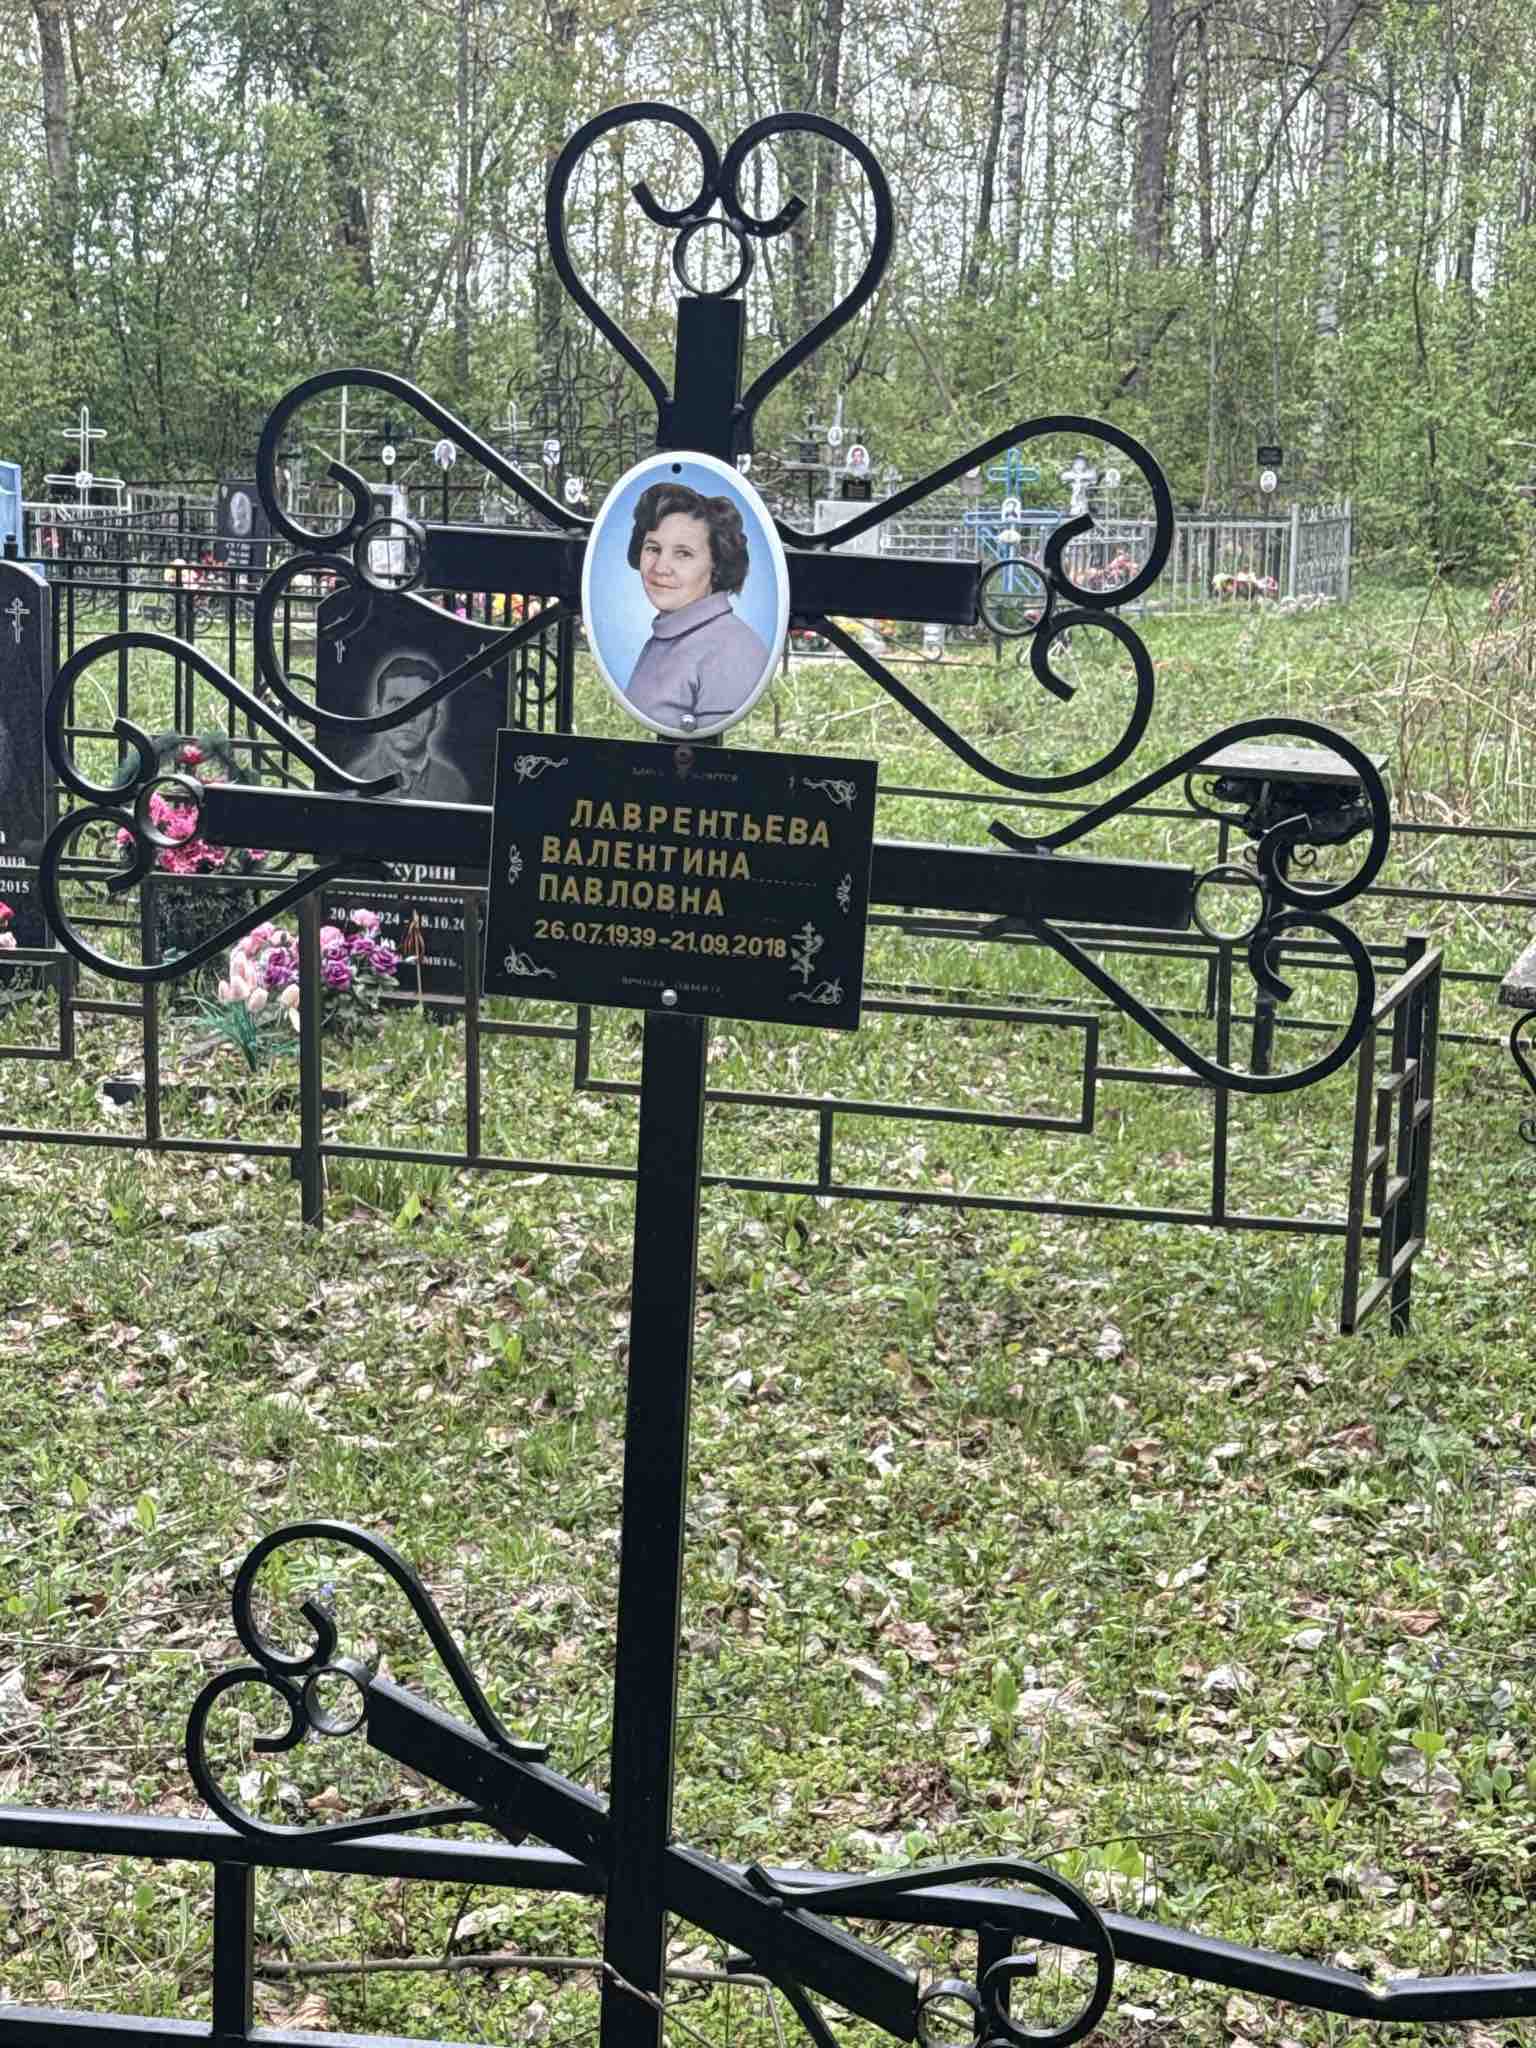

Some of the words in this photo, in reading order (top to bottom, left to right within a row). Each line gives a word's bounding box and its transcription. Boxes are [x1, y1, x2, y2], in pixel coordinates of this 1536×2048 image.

[569, 798, 831, 850] ЛАВРЕНТЬЕВА
[541, 835, 752, 881] ВАЛЕНТИНА
[538, 872, 725, 917] ПАВЛОВНА
